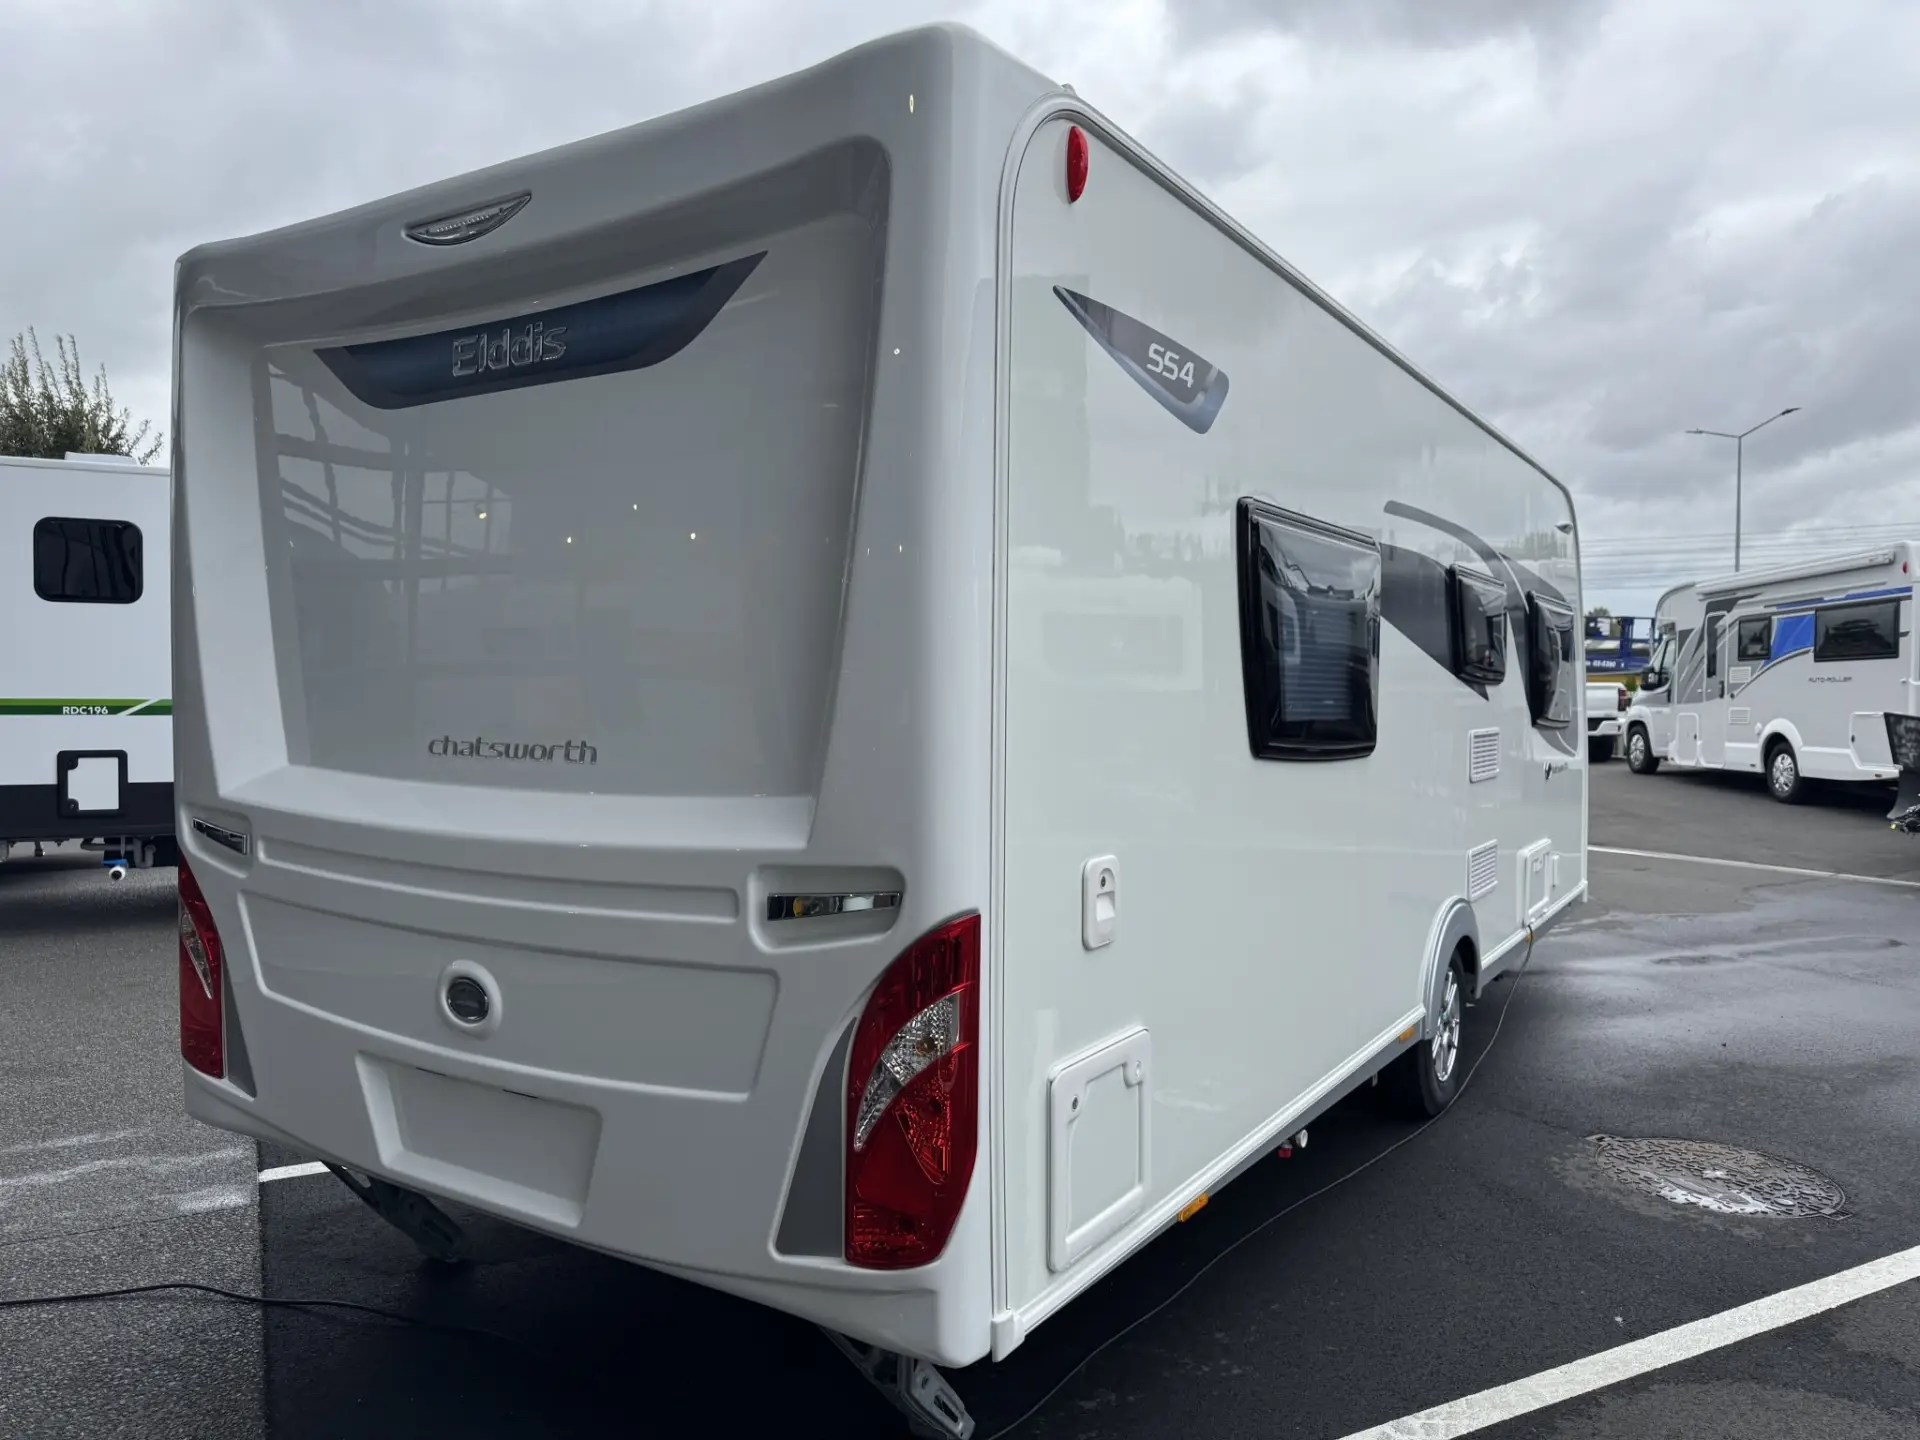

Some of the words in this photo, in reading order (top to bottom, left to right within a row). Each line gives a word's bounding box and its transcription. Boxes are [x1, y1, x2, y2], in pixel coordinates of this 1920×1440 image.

[452, 321, 567, 377] Elddis
[62, 705, 109, 715] RDC196
[428, 735, 598, 765] chatsworth
